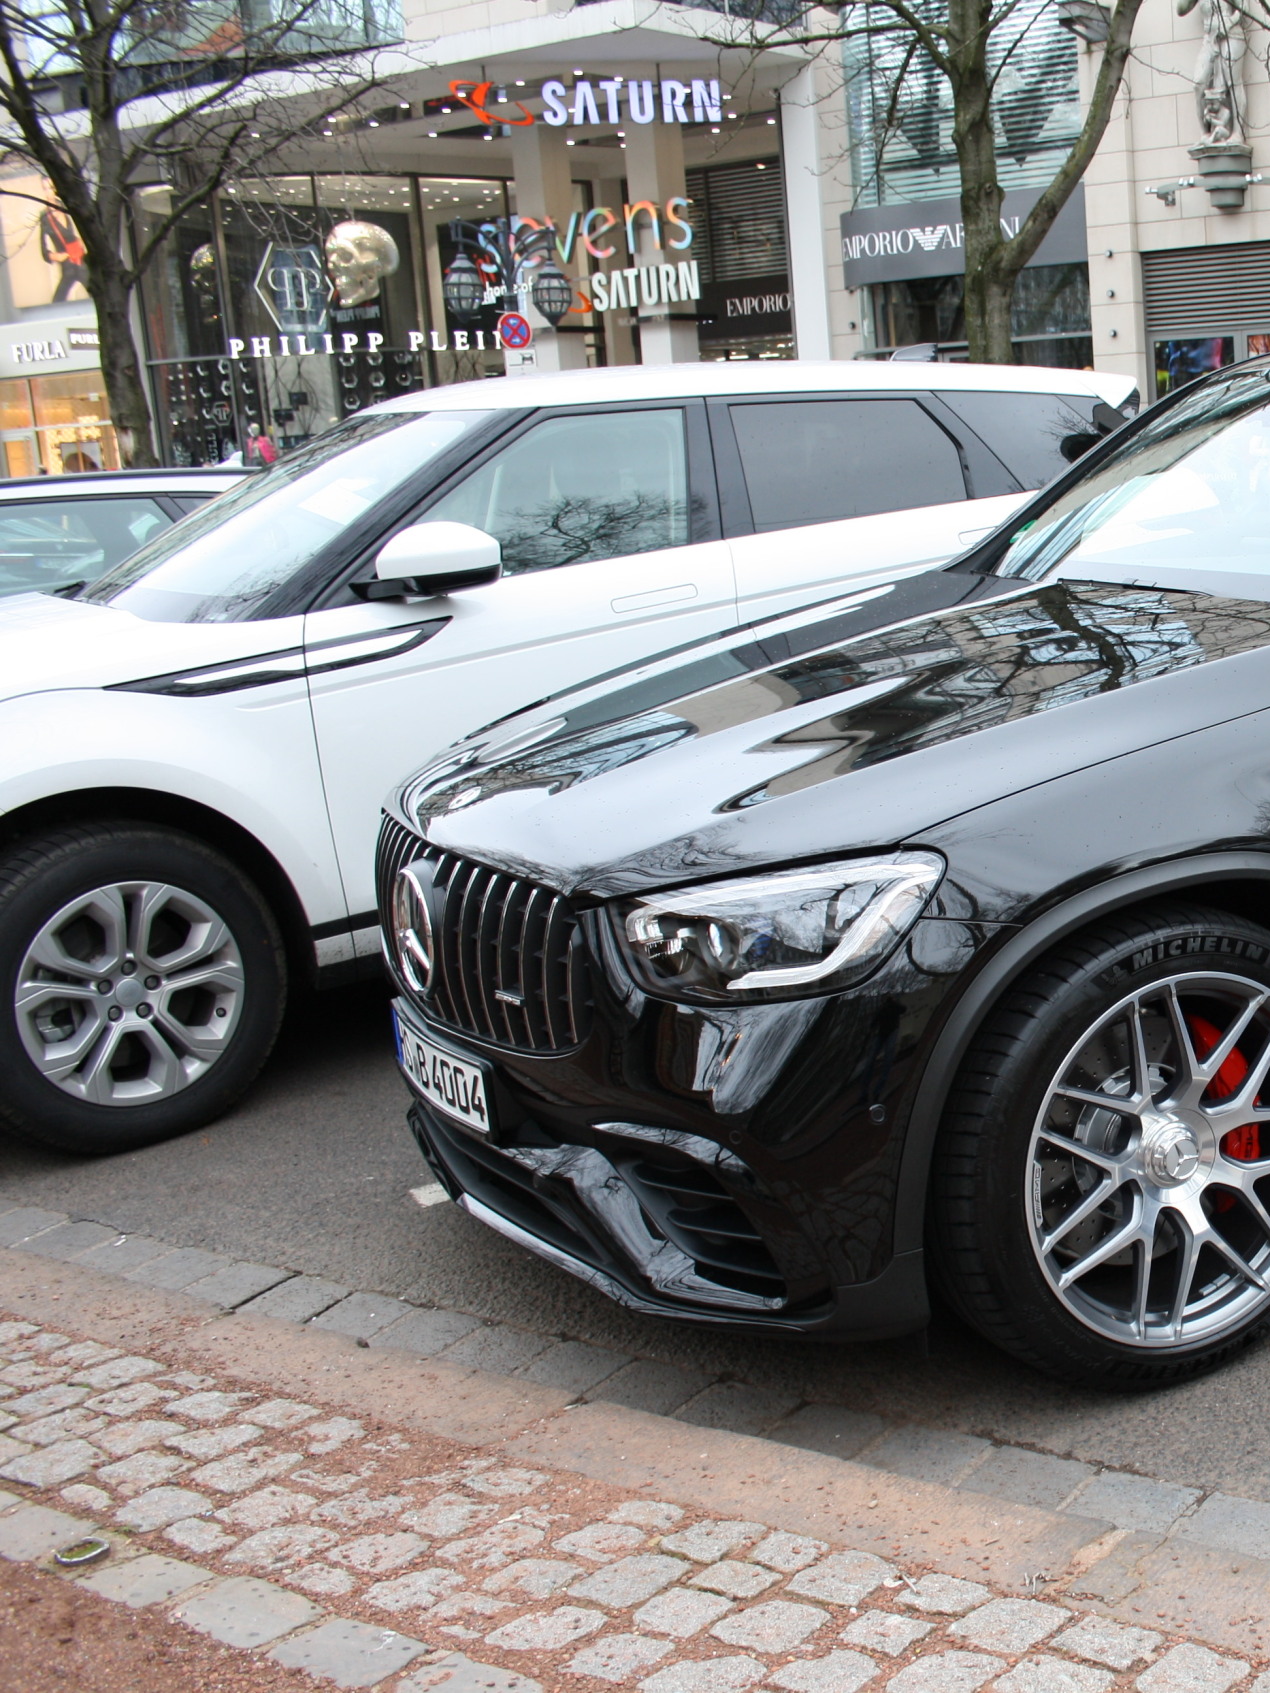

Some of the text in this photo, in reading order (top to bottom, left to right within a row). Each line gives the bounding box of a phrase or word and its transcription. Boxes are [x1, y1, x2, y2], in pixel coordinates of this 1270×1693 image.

[542, 79, 723, 126] SATURN
[842, 228, 914, 261] EMPORIO
[591, 260, 700, 312] SATURN
[726, 293, 791, 317] EMPORIO
[11, 340, 67, 363] FURLA
[69, 333, 100, 345] FURL
[229, 332, 384, 359] PHILIPP
[1131, 937, 1264, 971] MICHELIN
[432, 1055, 485, 1122] 4004
